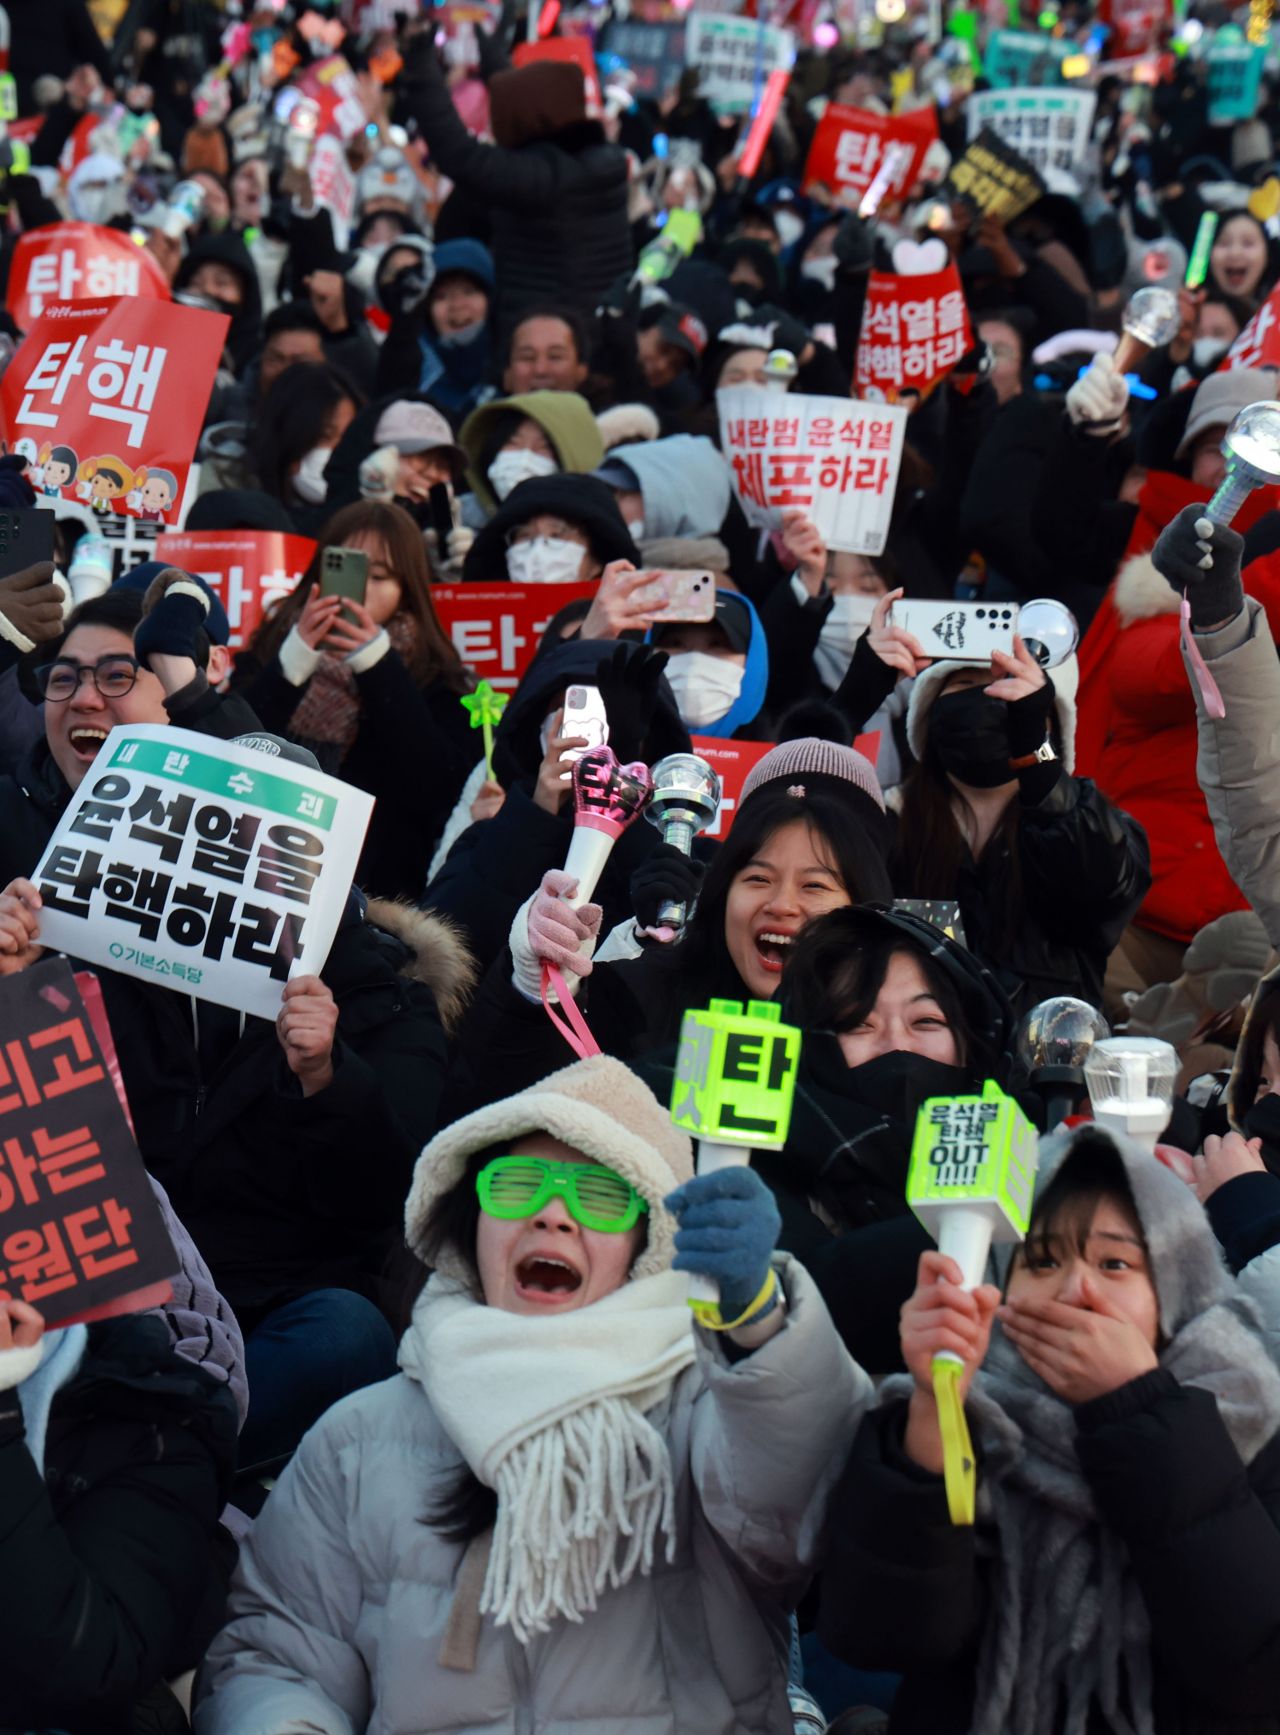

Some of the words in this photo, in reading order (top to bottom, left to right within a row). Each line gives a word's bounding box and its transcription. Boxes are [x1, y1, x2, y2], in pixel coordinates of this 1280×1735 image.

[15, 335, 168, 449] 탄핵
[728, 418, 799, 449] 내란범
[808, 418, 894, 450] 윤석열
[732, 453, 889, 509] 체포하라
[69, 774, 325, 905] 윤석열을
[40, 845, 307, 983] 탄핵하라
[124, 944, 204, 986] 기본소득당
[718, 1032, 792, 1134] 탄
[931, 1103, 999, 1124] 윤석열
[940, 1120, 985, 1144] 탄핵
[929, 1145, 990, 1165] OUT
[0, 1197, 139, 1304] 원단
